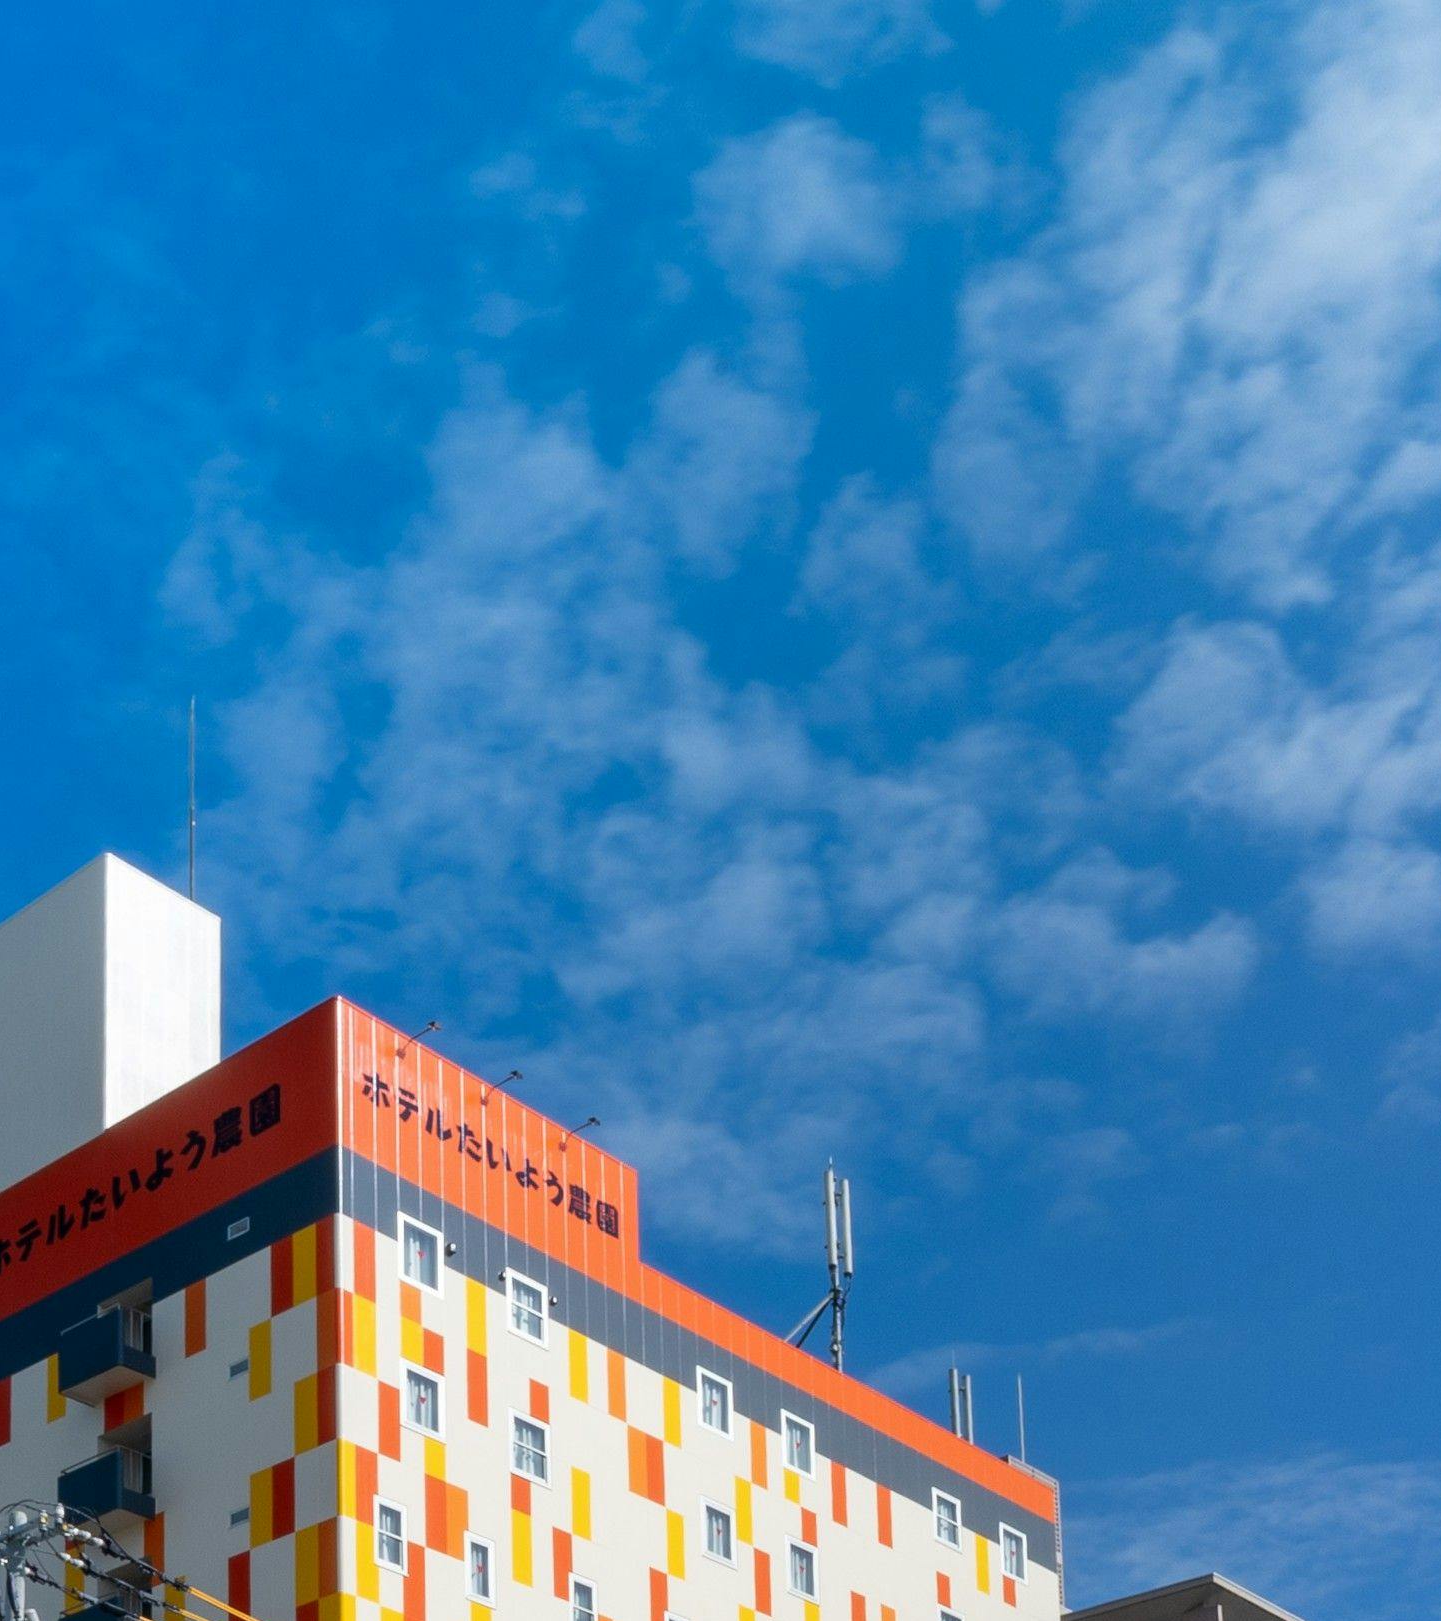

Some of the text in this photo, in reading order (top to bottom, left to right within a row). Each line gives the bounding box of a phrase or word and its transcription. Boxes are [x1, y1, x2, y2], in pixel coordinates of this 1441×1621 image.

[362, 1072, 619, 1239] ホテルたいよう農園
